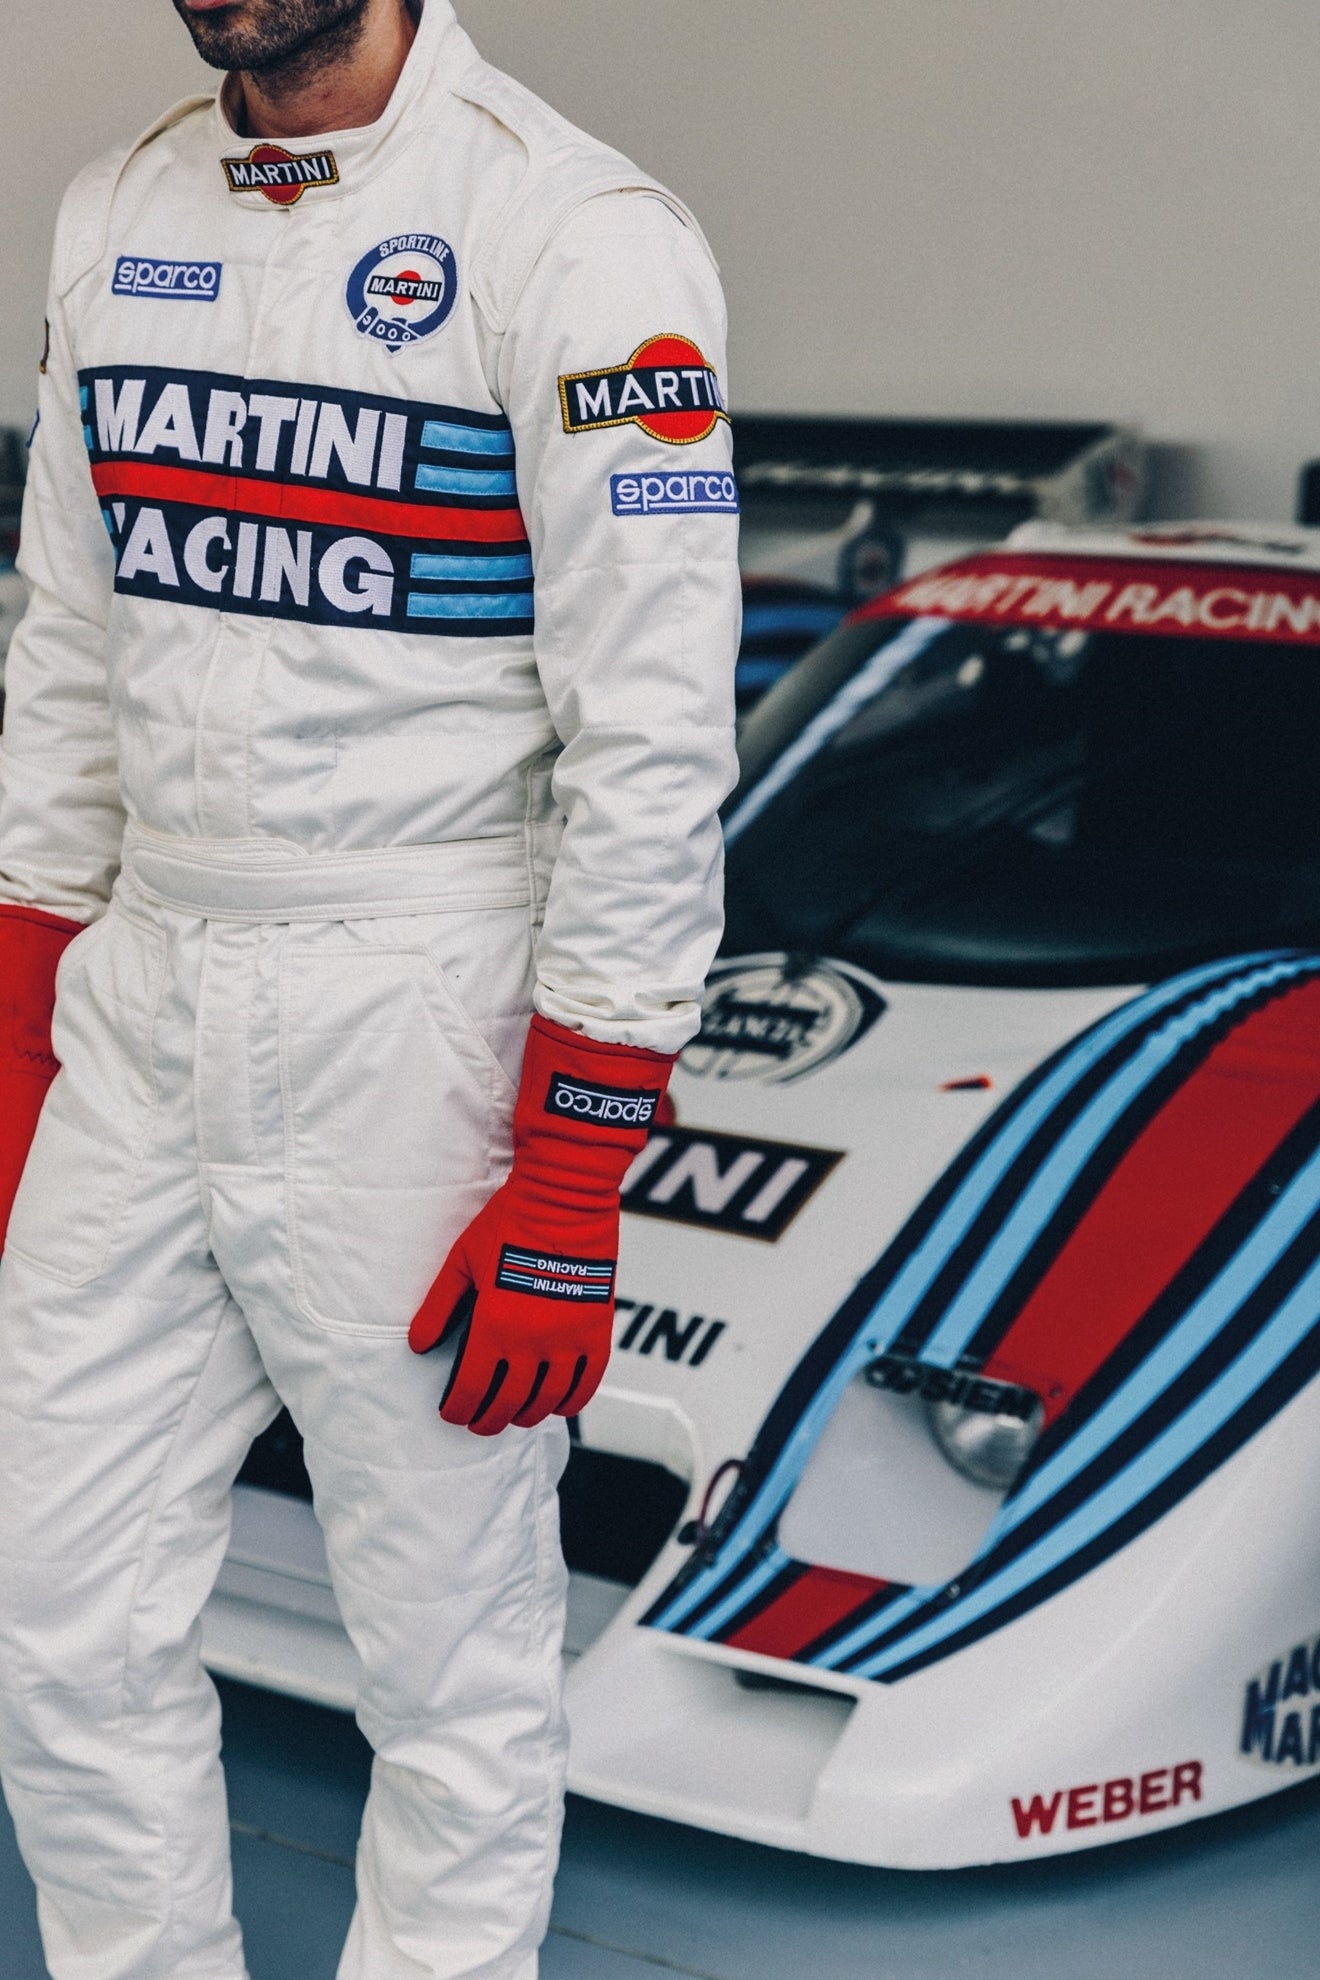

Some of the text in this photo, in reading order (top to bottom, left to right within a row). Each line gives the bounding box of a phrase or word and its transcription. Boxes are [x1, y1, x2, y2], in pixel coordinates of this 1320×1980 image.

[229, 156, 331, 185] MARTINI
[379, 235, 450, 262] SPORTLINE
[117, 261, 217, 293] sparco
[370, 278, 439, 298] MARTINI
[94, 379, 408, 492] MARTINI
[616, 475, 736, 511] sparco
[1105, 582, 1320, 634] RACIN
[555, 1086, 653, 1123] sparco
[537, 1258, 588, 1277] RACING
[532, 1277, 584, 1296] MARTINI
[1010, 1760, 1203, 1839] WEBER
